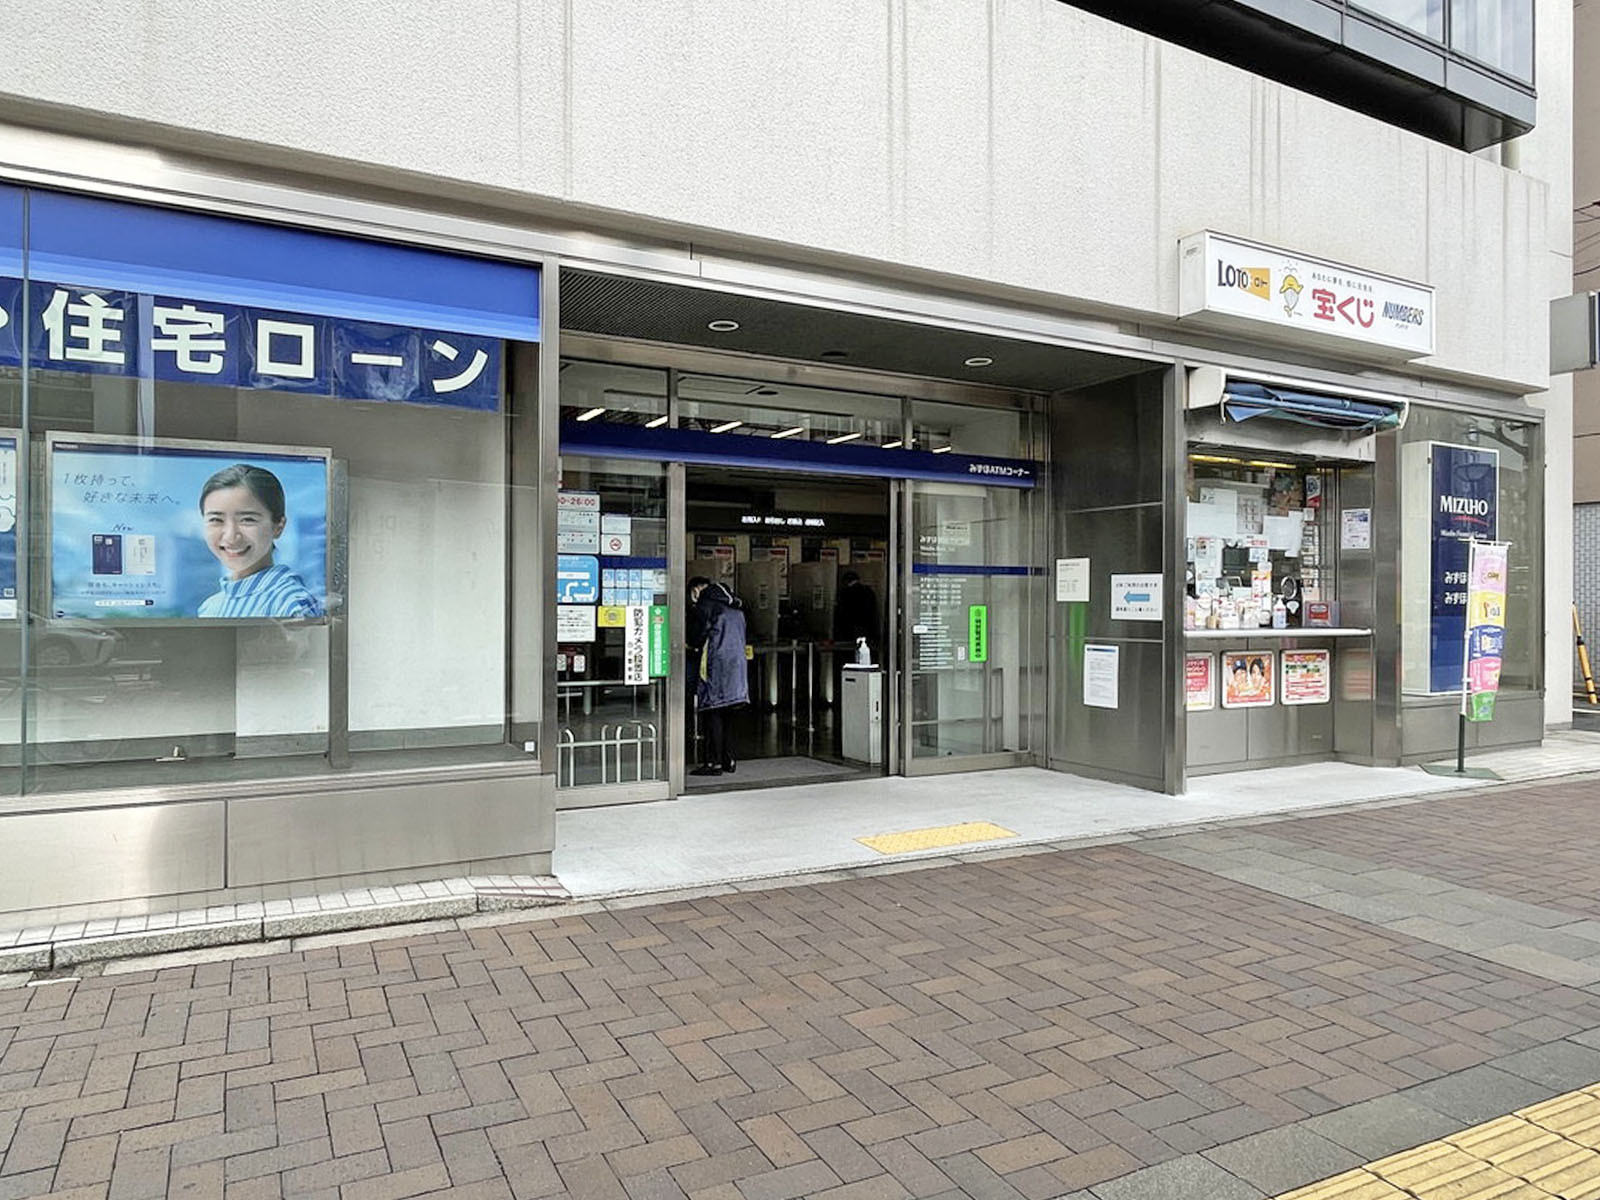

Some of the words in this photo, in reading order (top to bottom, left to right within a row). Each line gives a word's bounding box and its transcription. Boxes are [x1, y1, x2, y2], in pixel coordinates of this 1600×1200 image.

[1217, 259, 1249, 289] LOTO
[1311, 288, 1375, 329] 宝くじ
[1382, 300, 1425, 326] NUMBERS
[41, 289, 489, 394] 住宅ローン
[1440, 495, 1488, 517] MIZUHO
